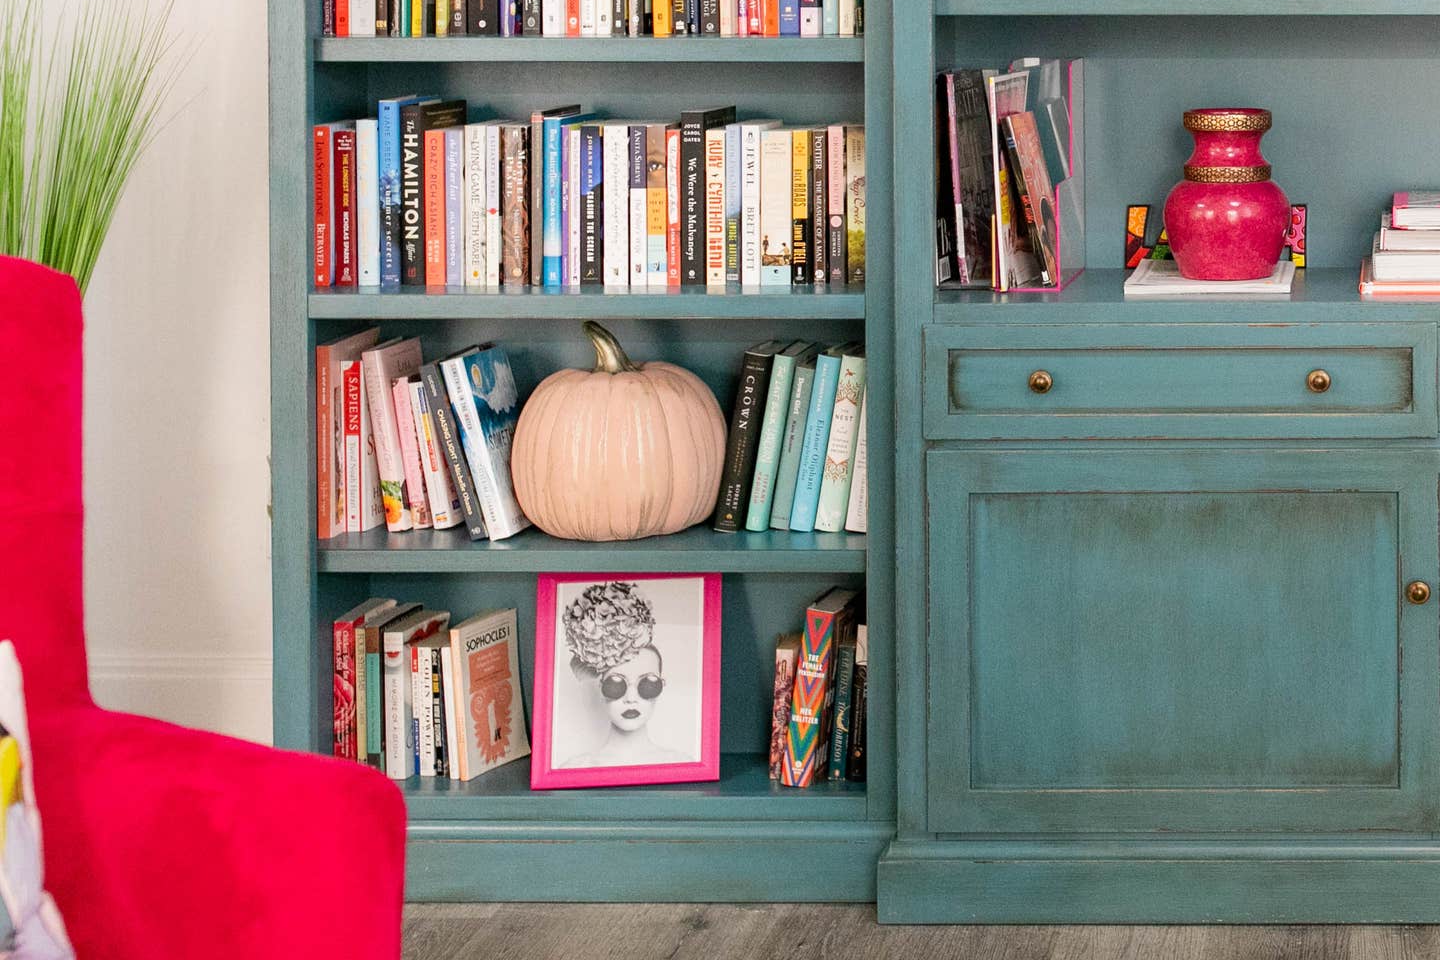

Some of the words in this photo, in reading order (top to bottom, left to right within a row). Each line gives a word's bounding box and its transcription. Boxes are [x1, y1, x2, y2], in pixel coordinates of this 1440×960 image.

[405, 120, 414, 133] The
[429, 138, 437, 170] CRAZY
[470, 141, 480, 170] LYING
[687, 157, 697, 169] We
[709, 139, 722, 168] RUBY
[746, 147, 755, 186] JEWEL
[404, 134, 418, 238] HAMILTON
[429, 174, 437, 197] RICH
[470, 173, 480, 204] GAME
[517, 150, 525, 202] MOTHER
[687, 172, 697, 193] Were
[687, 196, 697, 210] the
[709, 181, 722, 232] CYNTHIA
[429, 200, 437, 237] ASIANS
[470, 211, 480, 237] RUTH
[746, 206, 755, 237] BRET
[406, 241, 415, 262] Affair
[686, 213, 697, 260] Mulvaneys
[470, 240, 480, 265] WARE
[709, 237, 722, 267] BOND
[746, 240, 755, 270] LOTT
[348, 376, 359, 431] SAPIENS
[738, 376, 755, 429] CROWN
[437, 409, 452, 441] CHASING
[446, 440, 457, 461] LIGHT
[454, 463, 467, 492] Michelle
[461, 493, 473, 516] Obama
[465, 628, 507, 652] SOPHOCLES
[802, 662, 822, 671] FEMALE
[792, 715, 819, 725] WOLITZER
